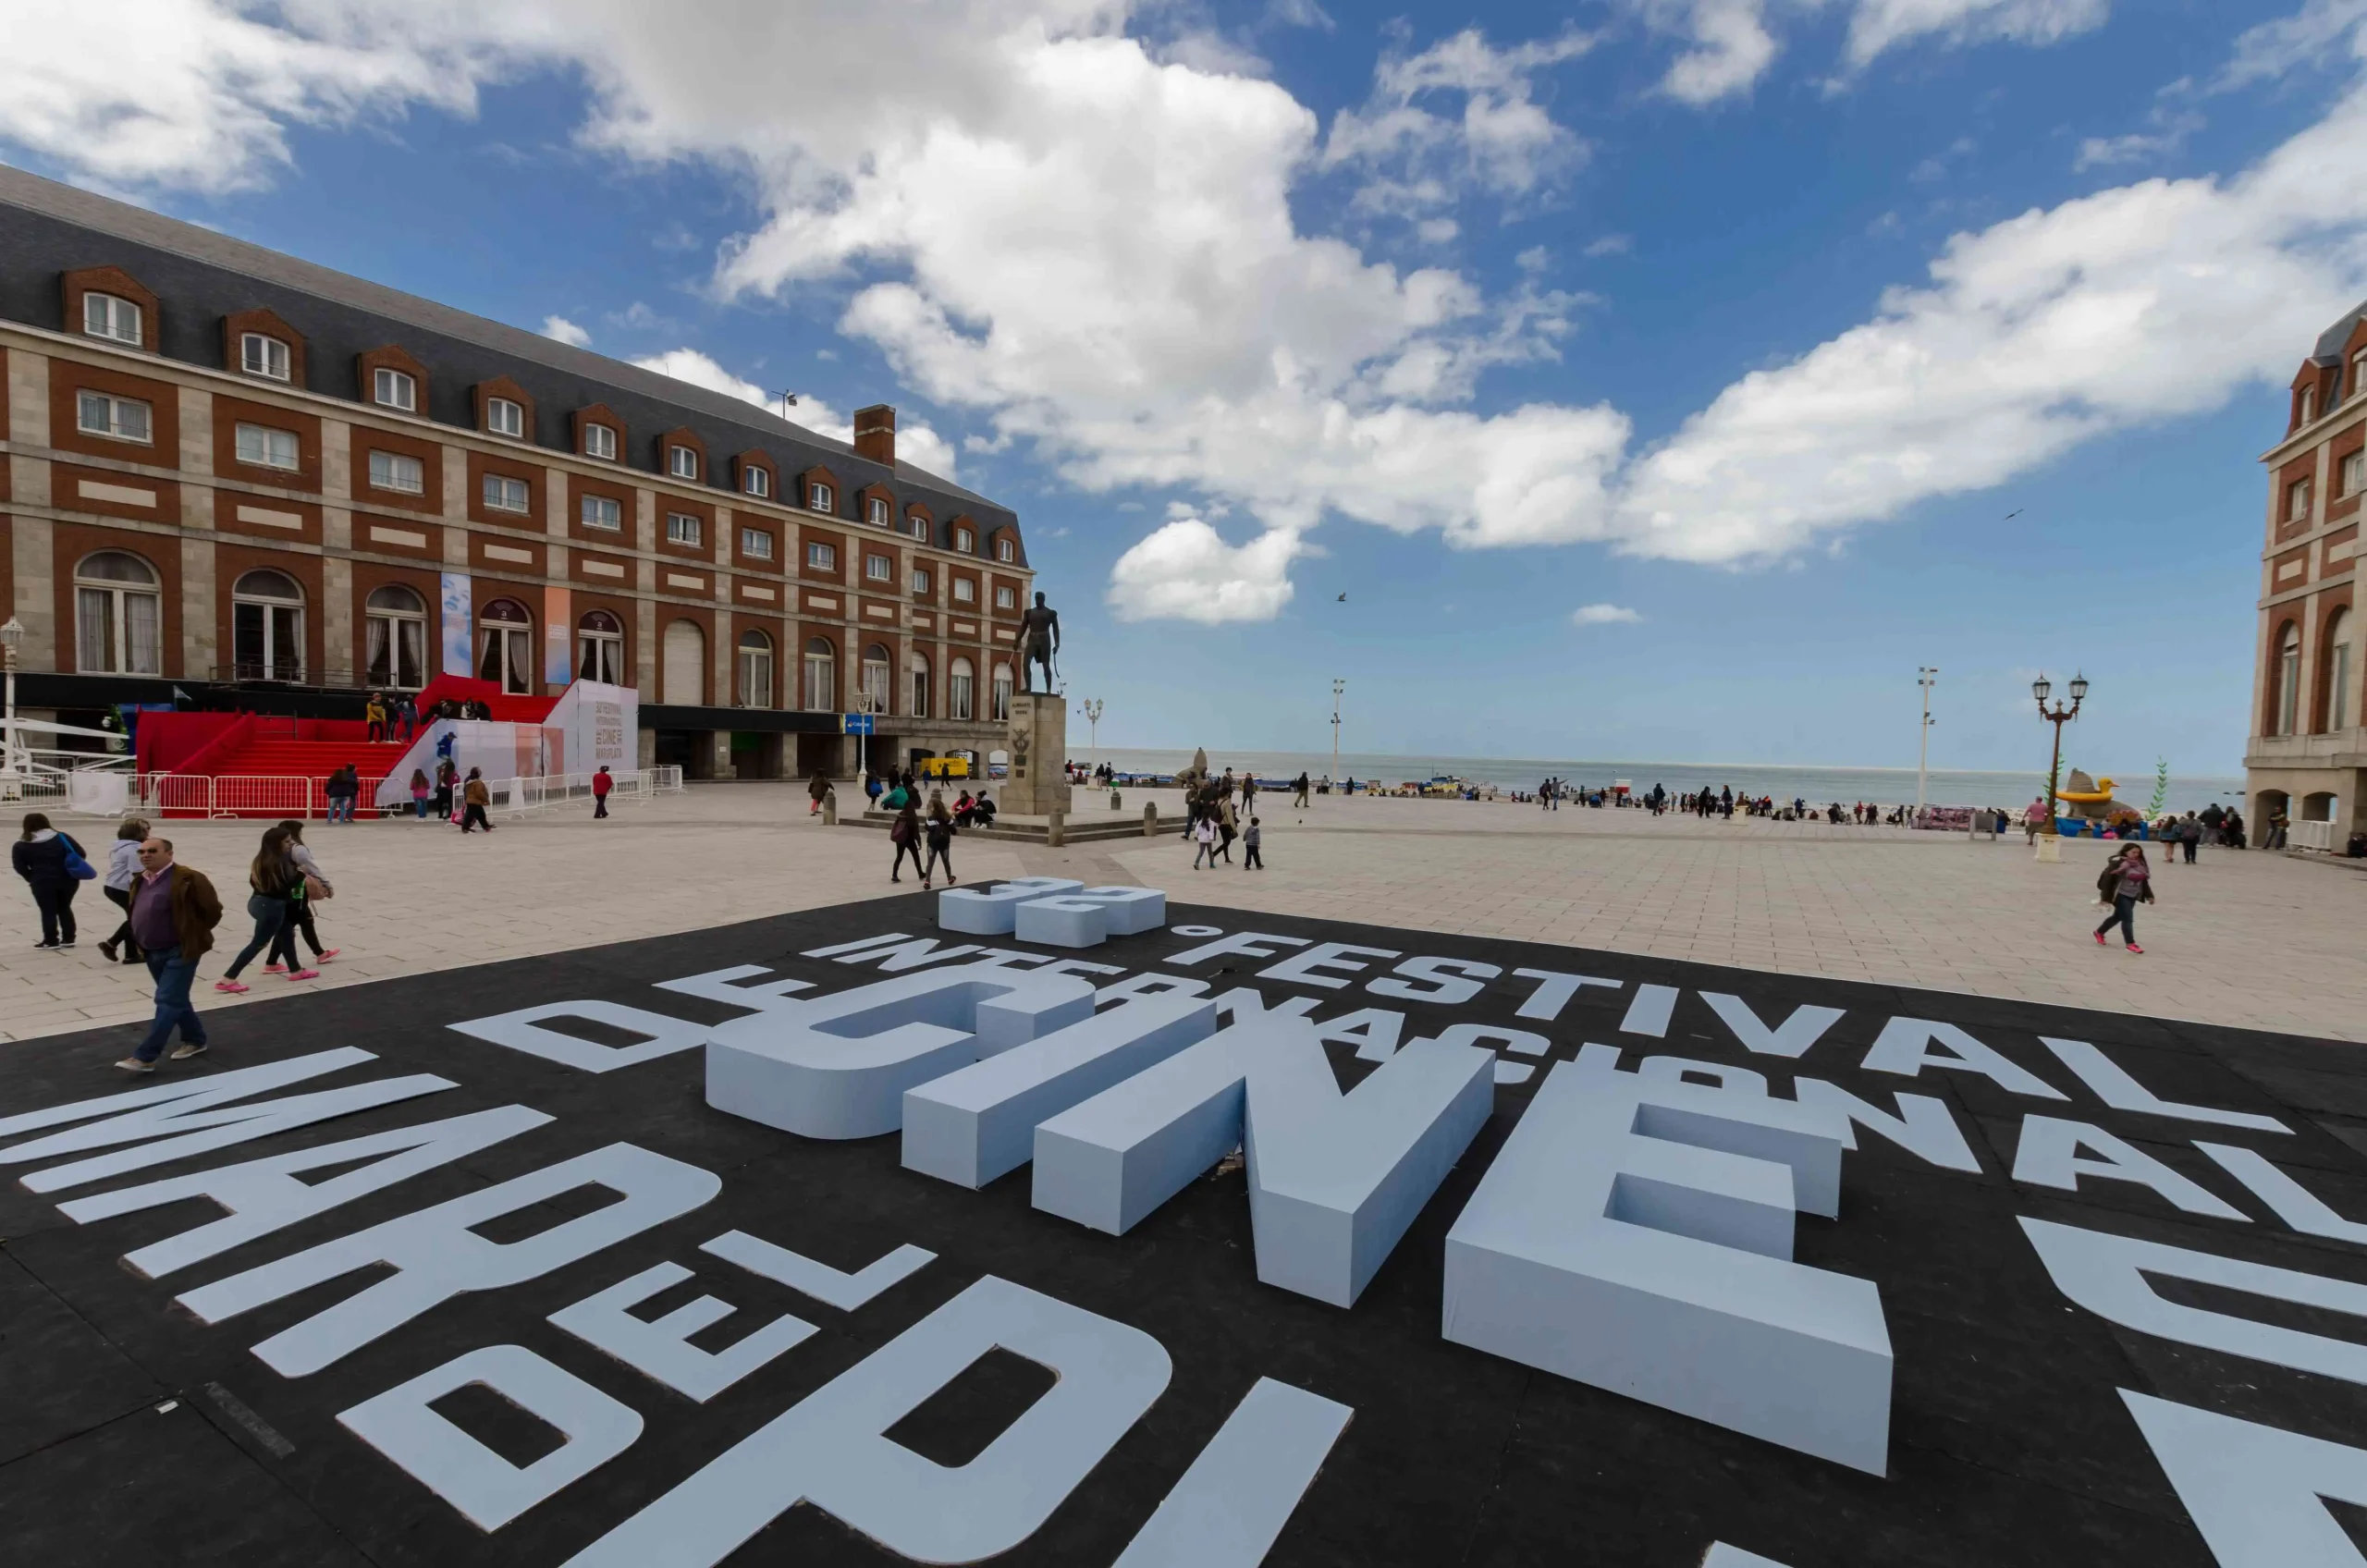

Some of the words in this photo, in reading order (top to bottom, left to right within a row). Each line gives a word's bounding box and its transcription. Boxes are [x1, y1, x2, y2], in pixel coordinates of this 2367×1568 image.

[1162, 931, 2297, 1134] FESTIVAL
[0, 1046, 723, 1379] MAR
[705, 965, 1894, 1477] CINE
[336, 1230, 938, 1535] DEL
